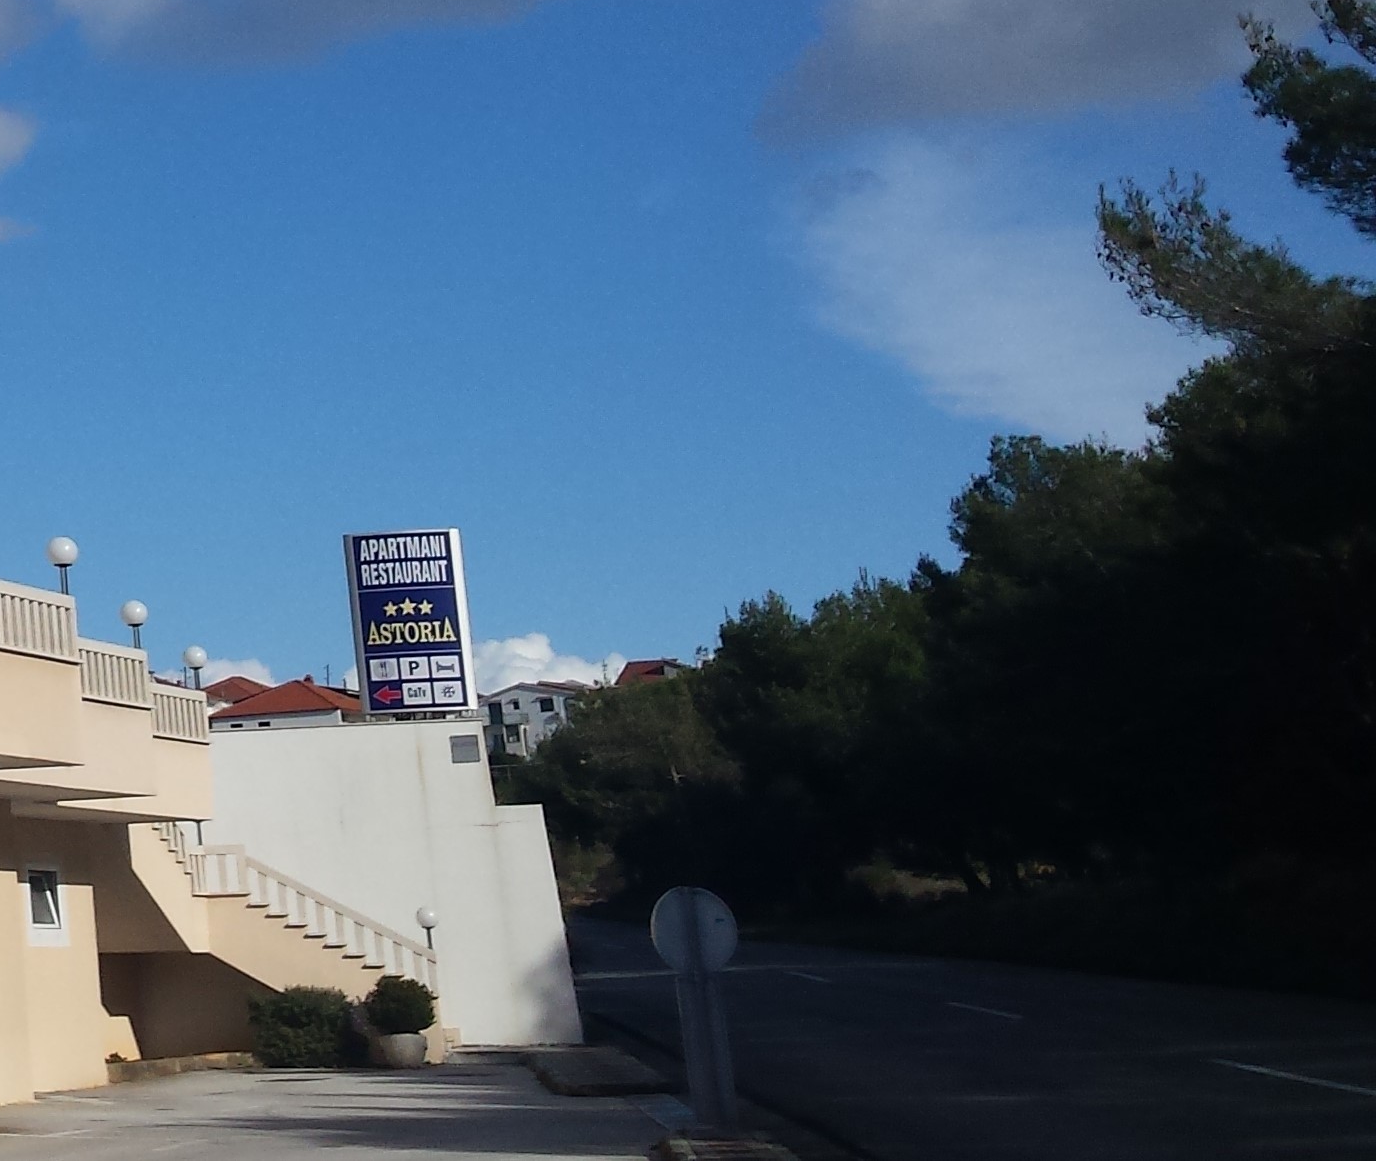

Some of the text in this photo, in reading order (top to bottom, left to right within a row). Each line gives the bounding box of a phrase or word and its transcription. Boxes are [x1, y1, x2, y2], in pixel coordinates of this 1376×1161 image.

[360, 535, 446, 561] APARTMANI
[361, 560, 448, 586] RESTAURANT
[367, 616, 457, 645] ASTORIA
[408, 660, 419, 675] P
